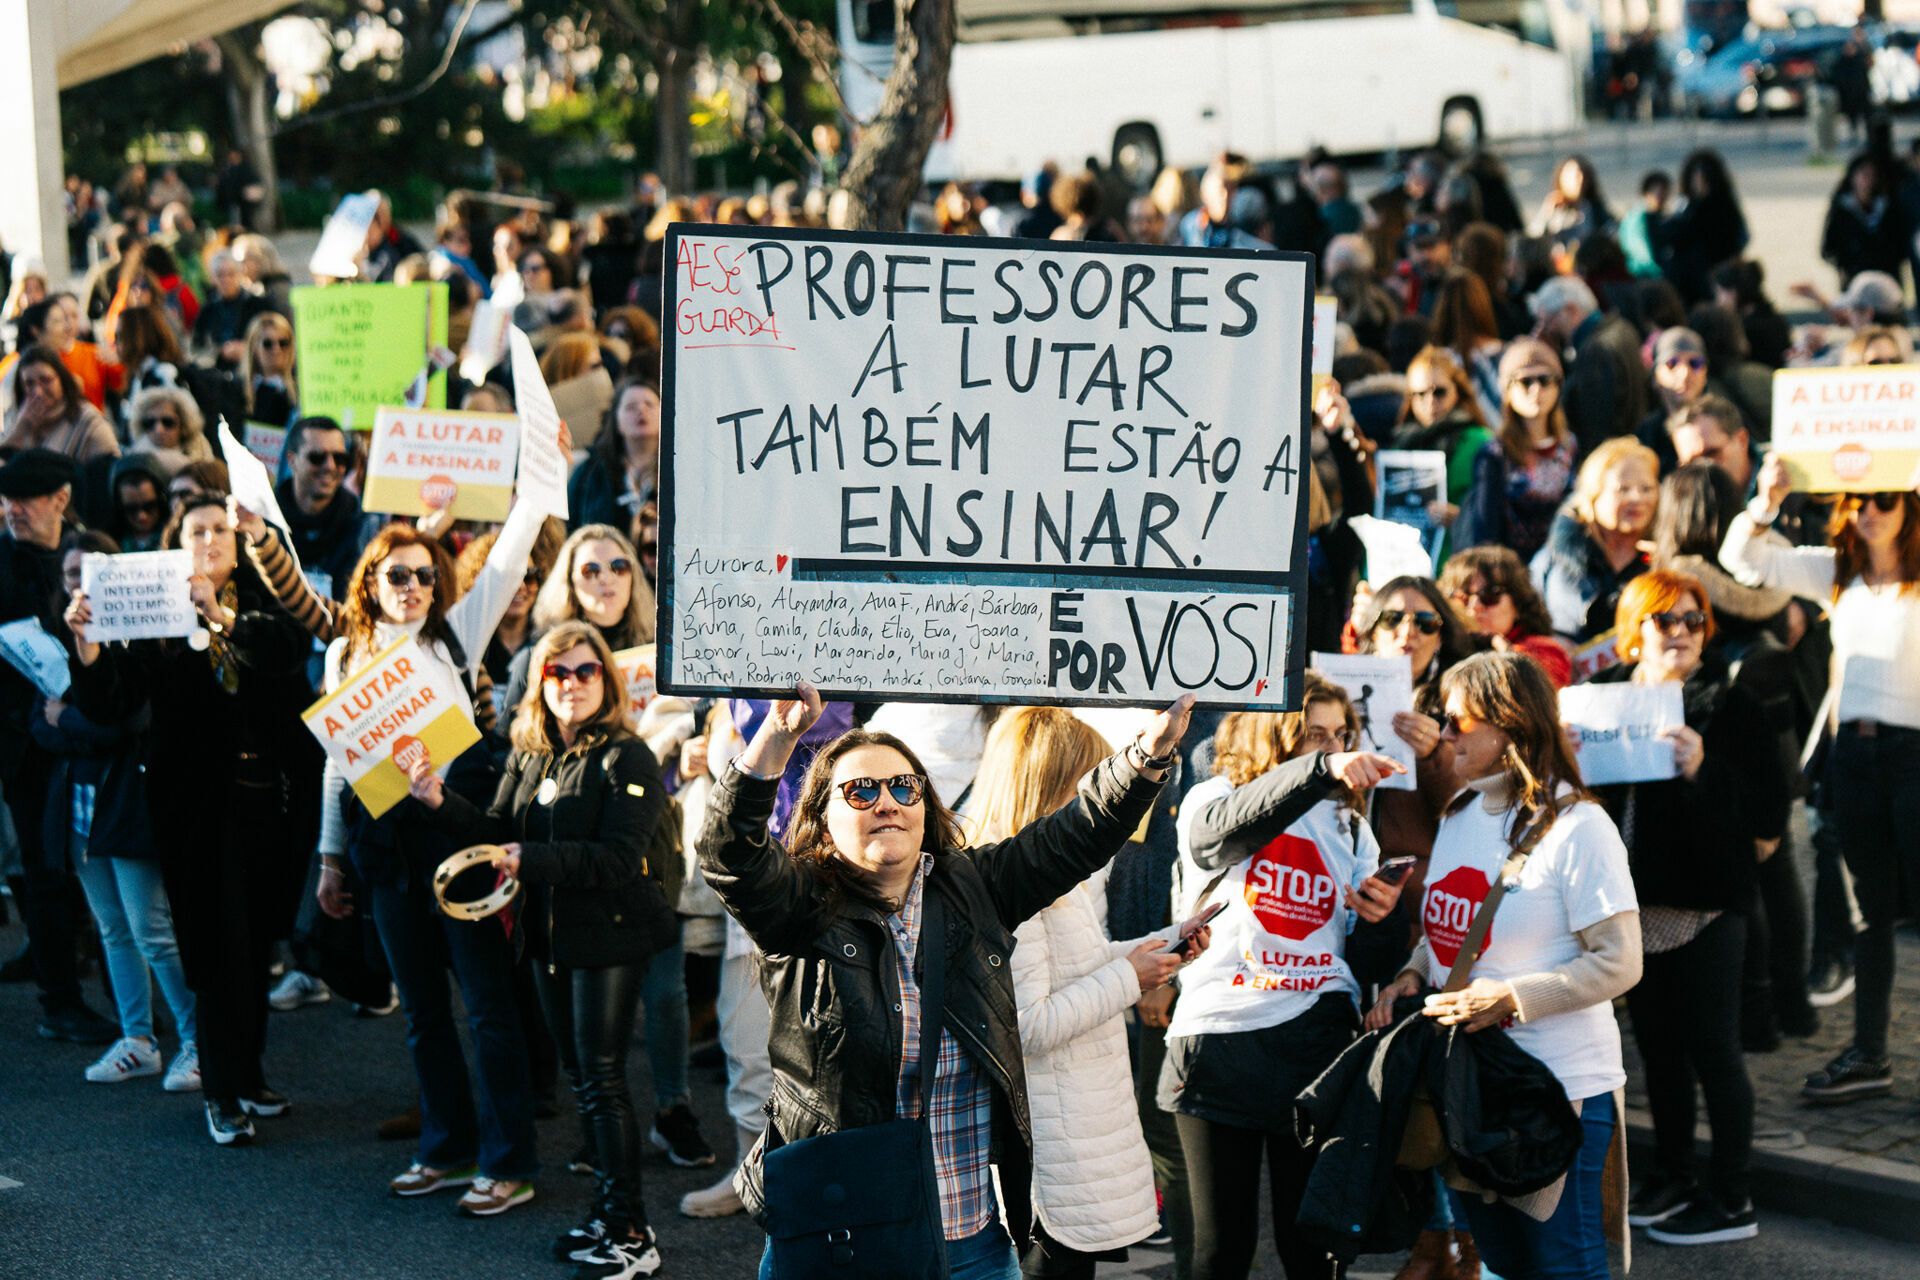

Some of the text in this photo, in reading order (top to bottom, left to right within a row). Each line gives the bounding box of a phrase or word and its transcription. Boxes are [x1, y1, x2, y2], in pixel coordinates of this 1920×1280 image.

[747, 241, 1259, 338] PROFESSORES
[676, 298, 782, 340] GUARDA
[851, 323, 1189, 418] A LUTAR
[1791, 383, 1916, 404] A LUTAR
[388, 420, 504, 444] A LUTAR
[717, 402, 1298, 495] TAMBÉM ESTÃO A
[384, 451, 500, 473] A ENSINAR
[840, 483, 1228, 569] ENSINAR!
[683, 548, 773, 576] Aurora,
[100, 616, 119, 627] DE
[104, 599, 177, 612] DO TEMPO
[688, 584, 761, 628] Afonso,
[1050, 588, 1084, 633] É
[683, 614, 745, 643] Bruna,
[755, 616, 808, 641] Camila,
[1048, 595, 1277, 695] POR VÓS!
[681, 641, 750, 661] Leonor,
[323, 657, 416, 739] A LUTAR
[345, 687, 438, 766] A ENSINAR
[1252, 859, 1334, 909] S.T.O.P.
[1262, 950, 1334, 967] LUTAR
[1232, 973, 1245, 987] A
